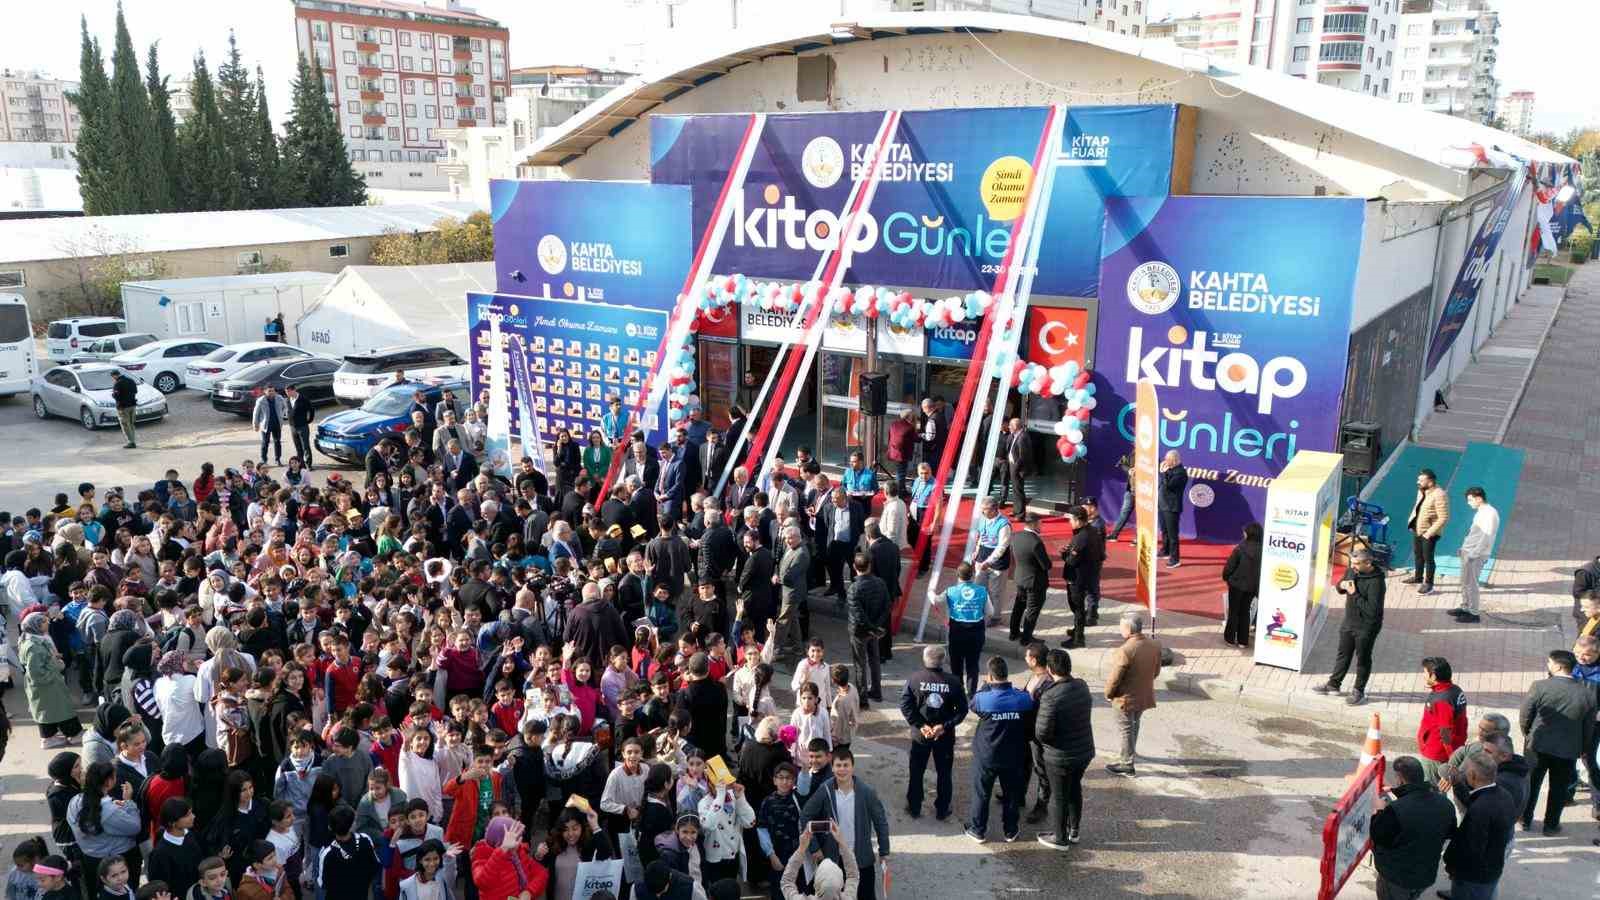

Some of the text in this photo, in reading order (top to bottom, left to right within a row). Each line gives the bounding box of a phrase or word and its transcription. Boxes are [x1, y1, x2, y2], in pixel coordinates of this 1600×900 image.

[1072, 132, 1110, 147] KİTAP
[1071, 147, 1109, 158] FUARI
[734, 184, 1012, 269] kitap Günle
[571, 241, 615, 260] KAHTA
[572, 256, 643, 277] BELEDİYESİ
[1189, 270, 1270, 294] KAHTA
[1188, 290, 1321, 318] BELEDİYESİ
[311, 331, 331, 344] AFAD
[934, 325, 976, 345] kitap
[1126, 324, 1308, 415] kitap
[1268, 535, 1306, 553] kitap
[919, 682, 950, 693] ZABITA
[991, 712, 1020, 721] ZABITA
